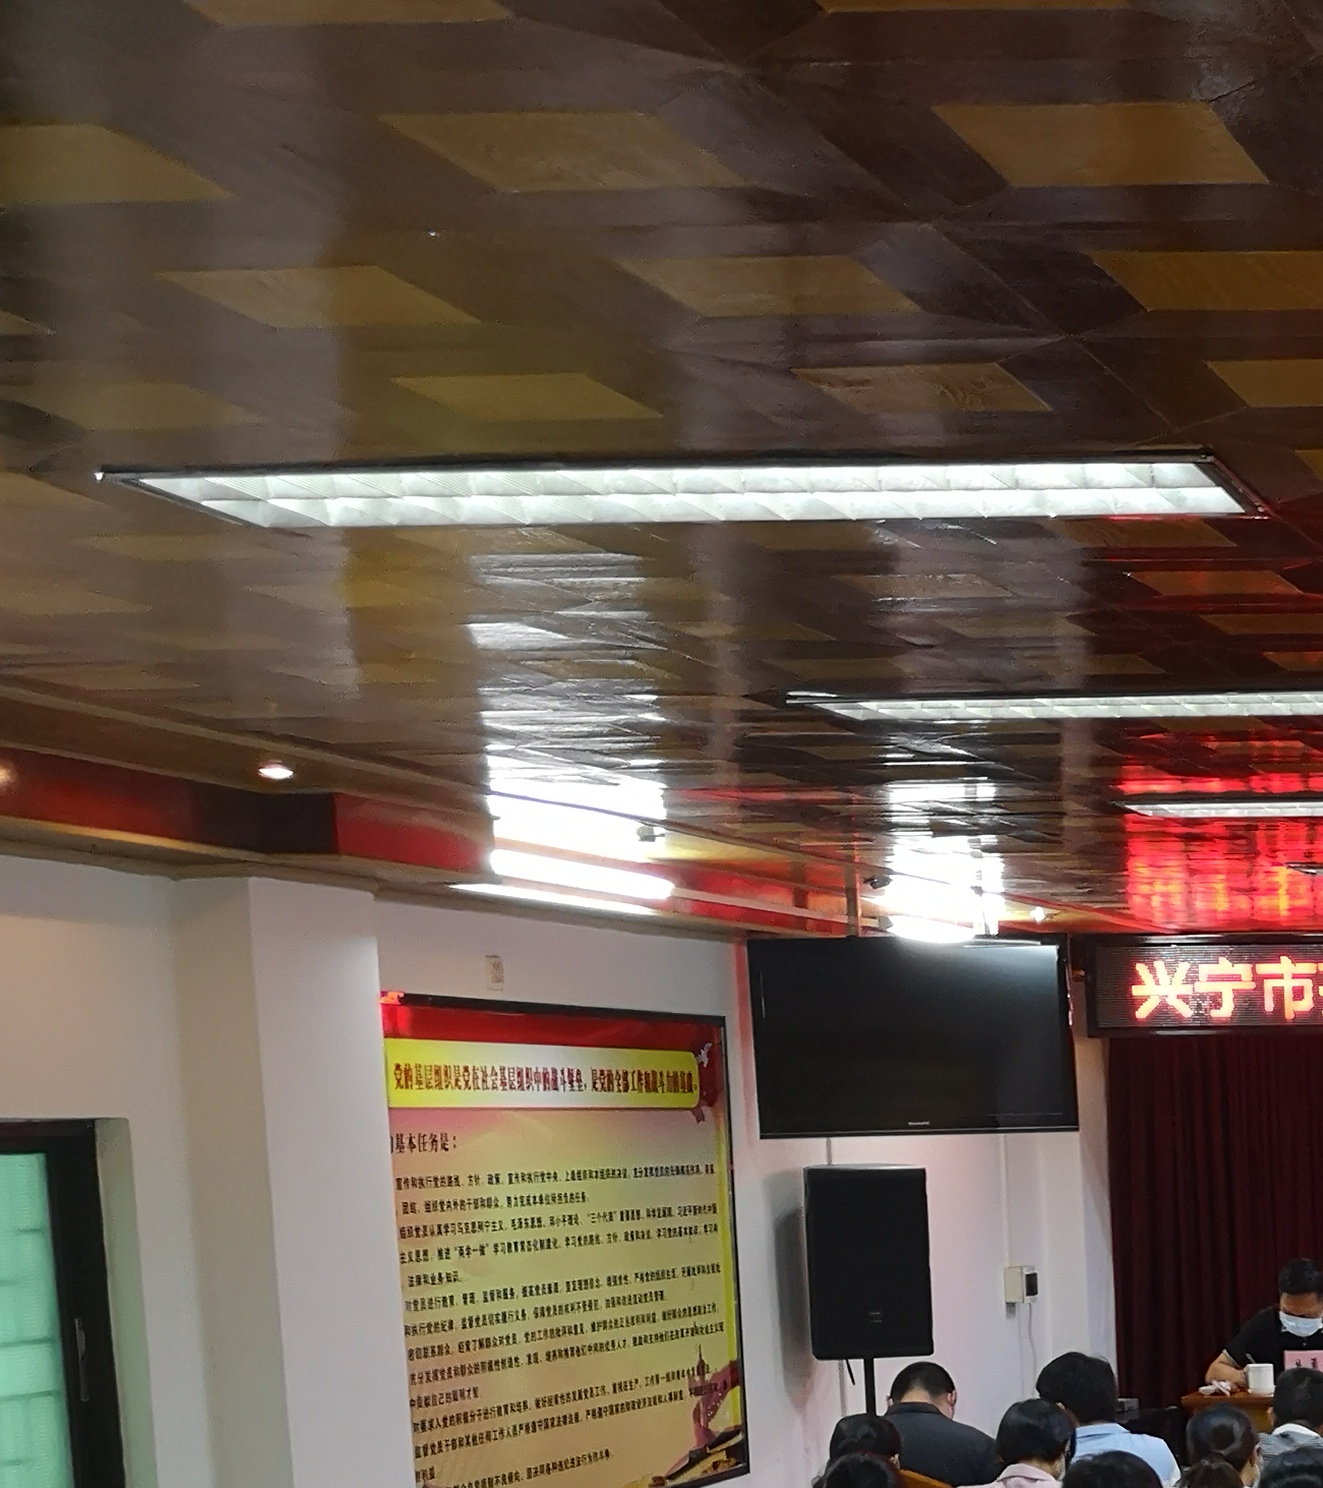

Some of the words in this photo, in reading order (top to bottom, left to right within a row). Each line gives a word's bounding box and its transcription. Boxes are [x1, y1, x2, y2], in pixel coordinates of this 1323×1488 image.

[390, 1133, 456, 1153] 基本任务是:
